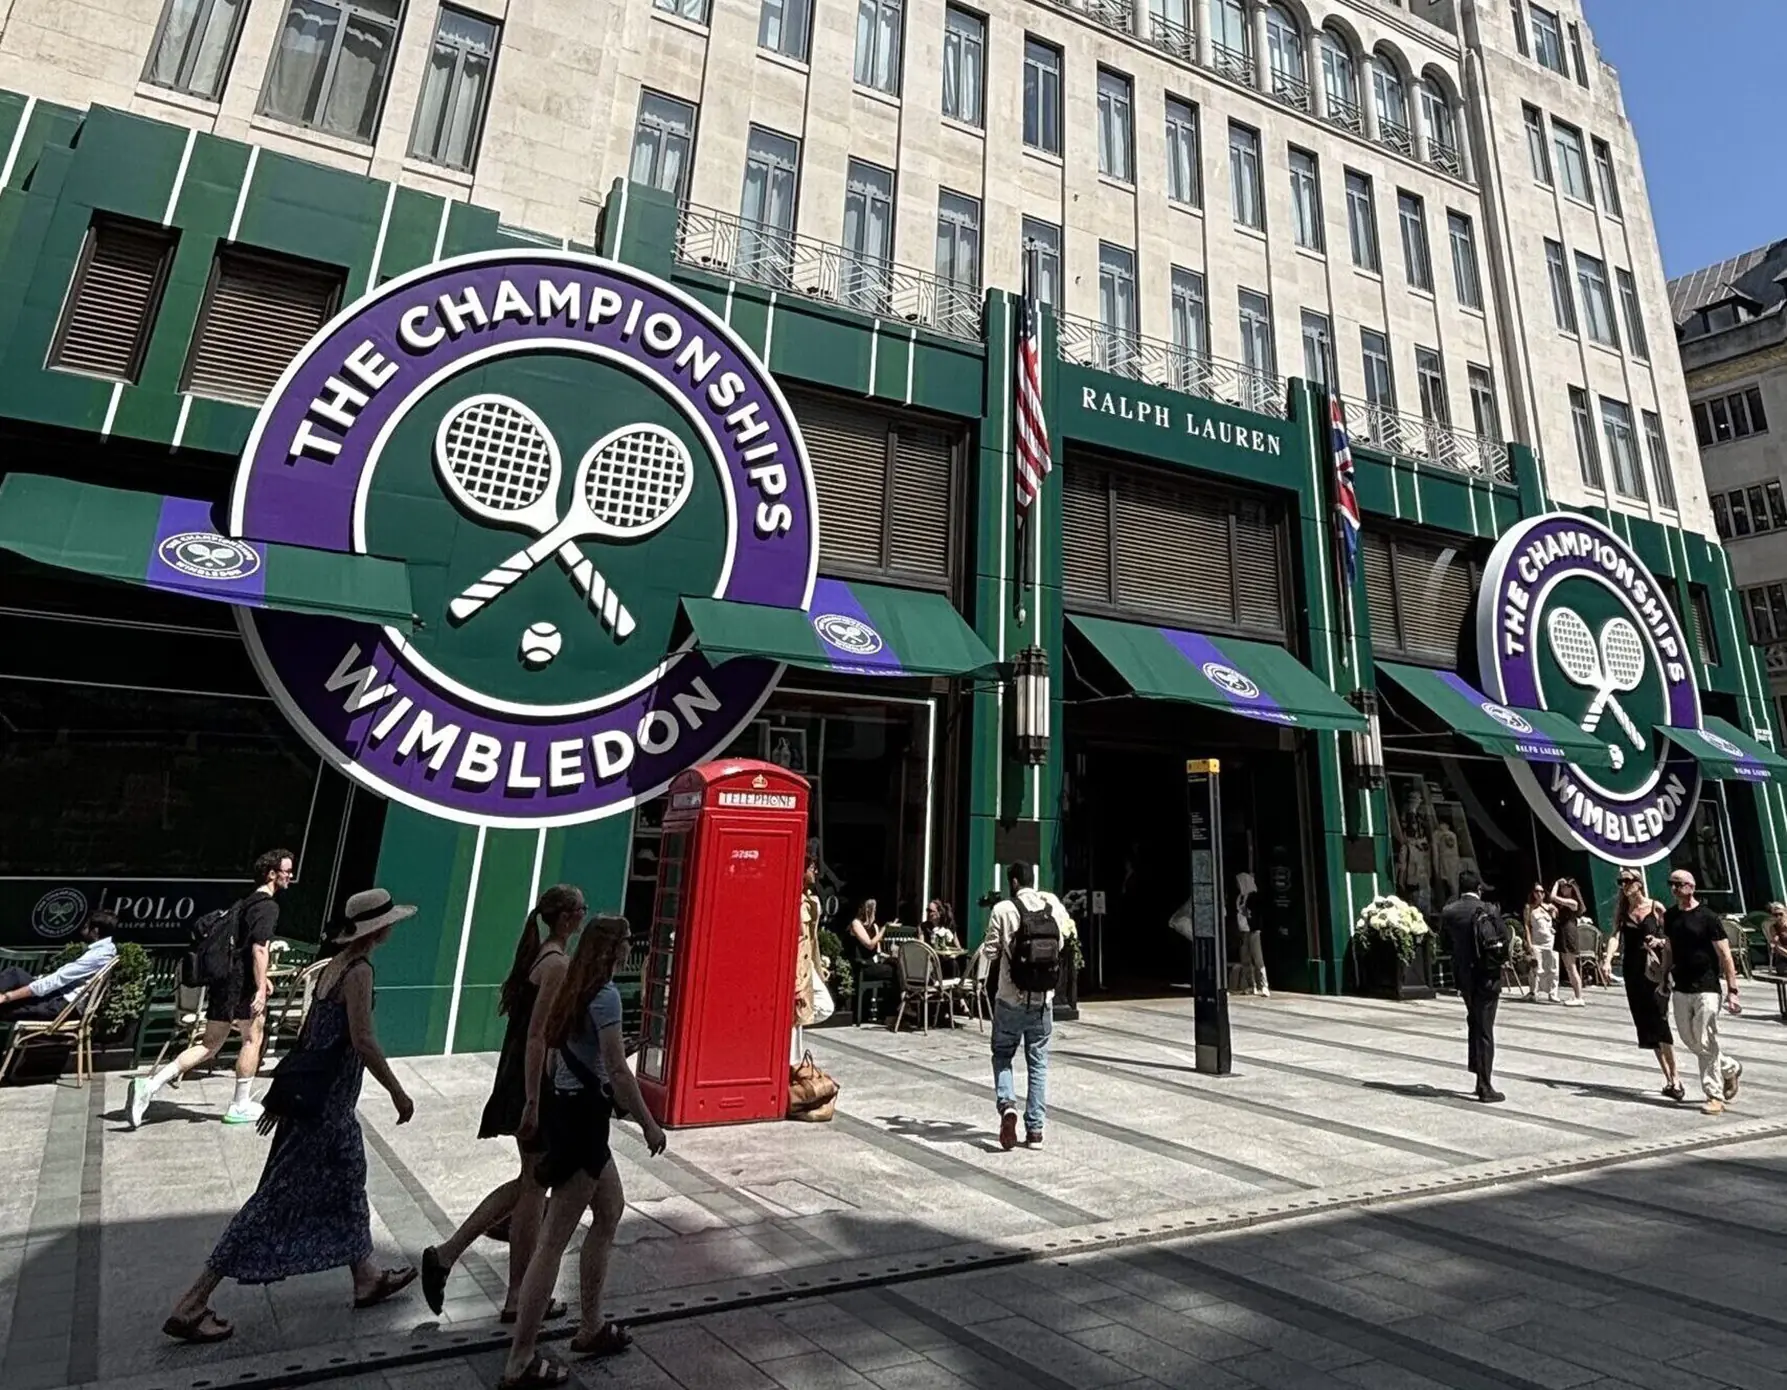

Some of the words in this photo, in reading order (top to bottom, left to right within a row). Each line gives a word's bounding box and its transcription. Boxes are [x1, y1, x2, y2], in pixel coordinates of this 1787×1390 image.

[289, 340, 399, 461] THE
[400, 279, 793, 532] CHAMPIONSHIPS
[1081, 386, 1170, 428] RALPH
[1186, 413, 1281, 456] LAUREN
[1504, 580, 1530, 655] THE
[1518, 531, 1685, 682] CHAMPIONSHIPS
[324, 642, 722, 789] WIMBLEDON
[723, 793, 793, 808] TELEPHONE
[1551, 763, 1686, 843] WIMBLEDON
[113, 895, 195, 920] POLO
